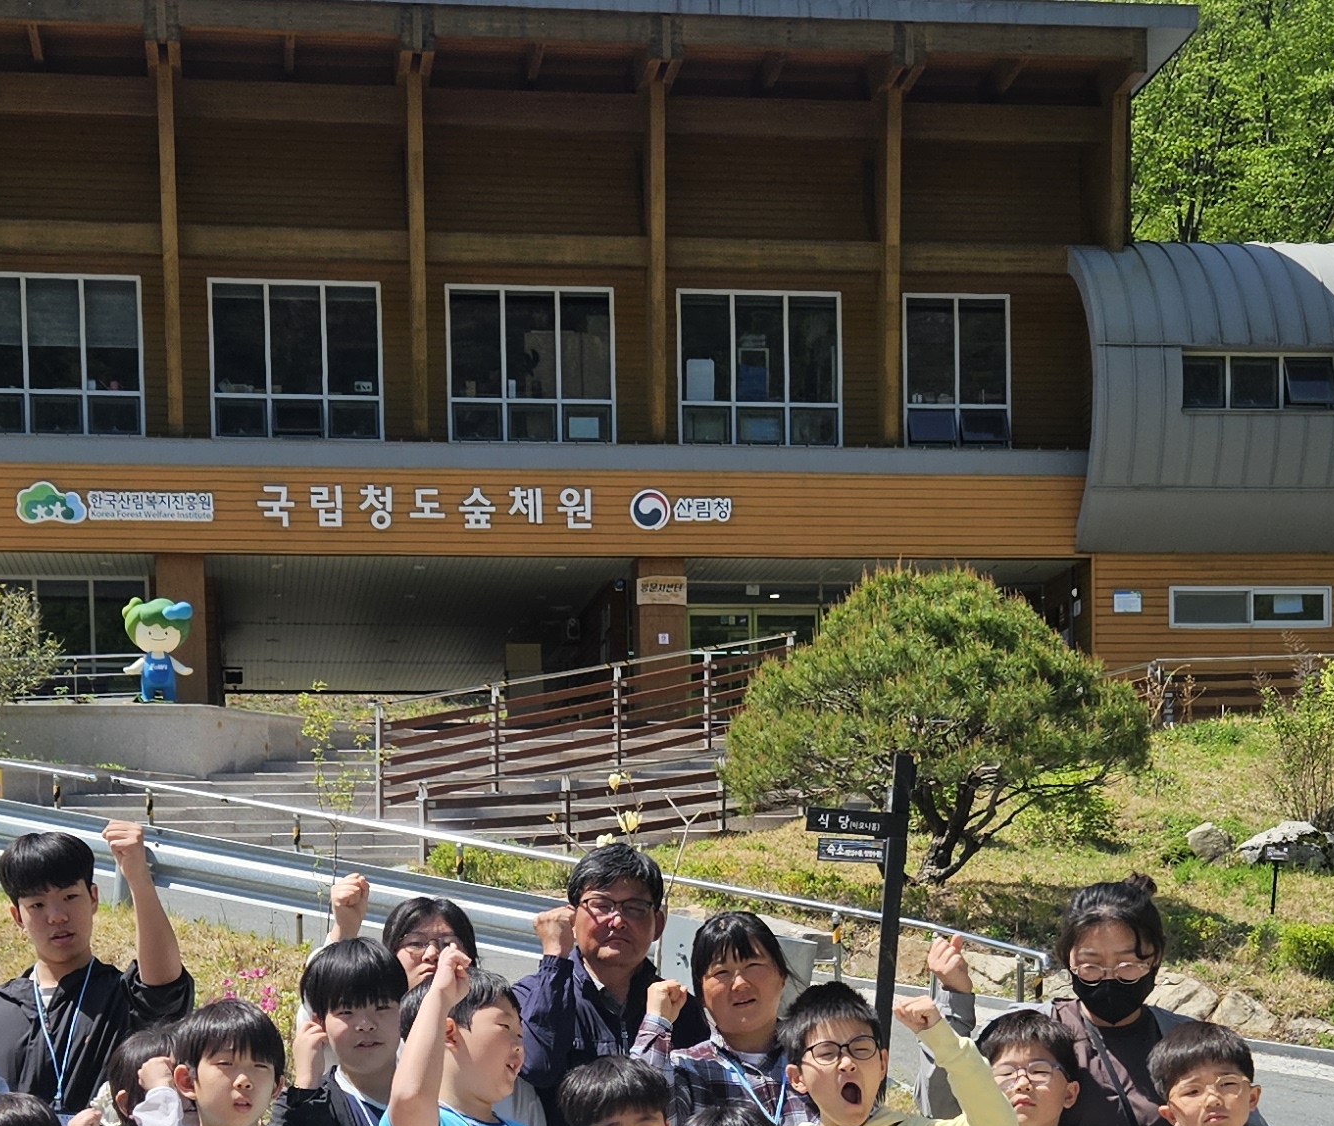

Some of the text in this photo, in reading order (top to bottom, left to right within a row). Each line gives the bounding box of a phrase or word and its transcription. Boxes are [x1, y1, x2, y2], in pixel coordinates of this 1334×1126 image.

[90, 493, 212, 511] 한국산림복지진흥원
[256, 485, 593, 530] 국립청도숲체원
[675, 498, 731, 520] 산림청
[90, 510, 211, 519] Korea Forest Welfare Institute
